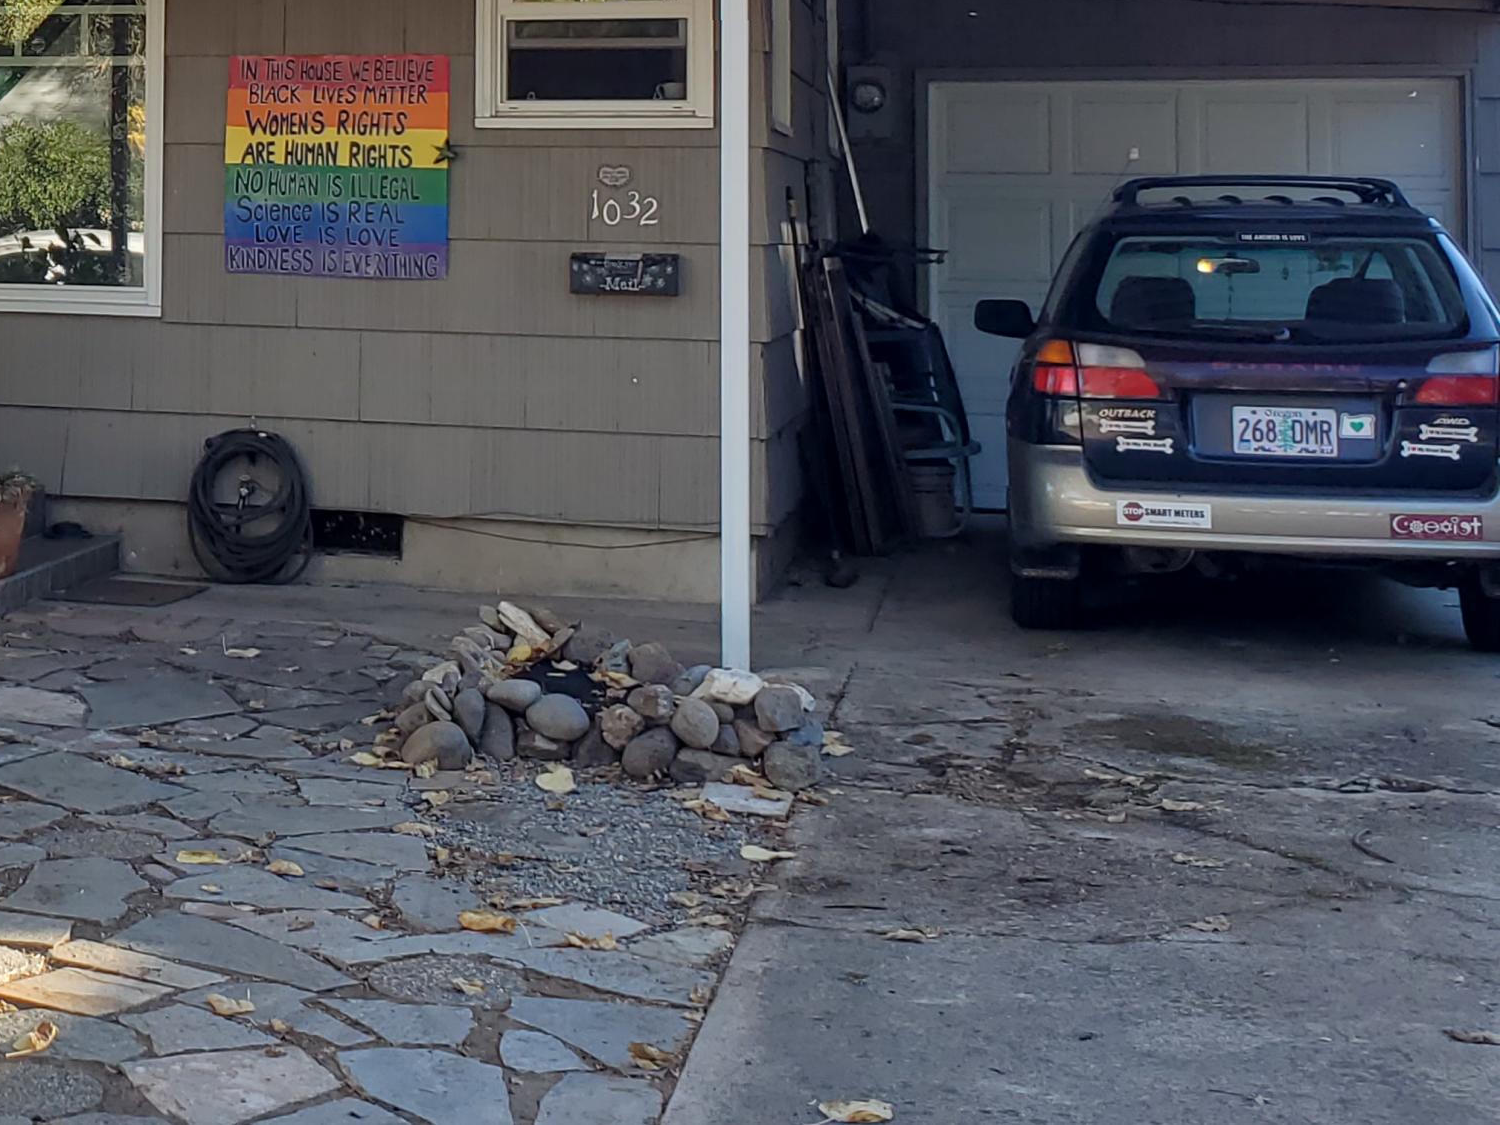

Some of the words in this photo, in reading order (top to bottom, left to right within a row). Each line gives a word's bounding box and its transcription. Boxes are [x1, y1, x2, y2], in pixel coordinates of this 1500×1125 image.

[241, 58, 257, 82] IN
[265, 58, 296, 81] THIS
[301, 60, 344, 82] HOUSE
[350, 60, 369, 82] WE
[373, 60, 436, 83] BELIEVE
[249, 83, 302, 105] BLACK
[312, 84, 357, 105] LIVES
[363, 84, 428, 105] MATTER
[245, 109, 325, 137] WOMEN'S
[336, 109, 408, 137] RIGHTS
[240, 141, 276, 165] ARE
[285, 140, 339, 167] HUMAN
[350, 141, 413, 169] RIGHTS
[235, 169, 264, 196] NO
[268, 170, 319, 196] HUMAN
[328, 175, 343, 198] IS
[351, 175, 420, 201] ILLEGAL
[236, 195, 312, 223] Science
[321, 201, 340, 224] IS
[348, 201, 405, 224] REAL
[591, 189, 658, 225] 1032
[255, 224, 303, 244] LOVE
[319, 227, 336, 246] IS
[346, 226, 400, 247] LOVE
[228, 245, 314, 273] KINDNESS
[322, 249, 338, 273] IS
[343, 251, 439, 278] EVERYTHING
[1098, 408, 1157, 418] OUTBACK
[1433, 417, 1471, 425] AWD
[1238, 418, 1277, 443] 268
[1291, 419, 1332, 446] DMR
[1123, 507, 1145, 516] STOP
[1145, 507, 1173, 517] SMART
[1174, 509, 1205, 519] METERS
